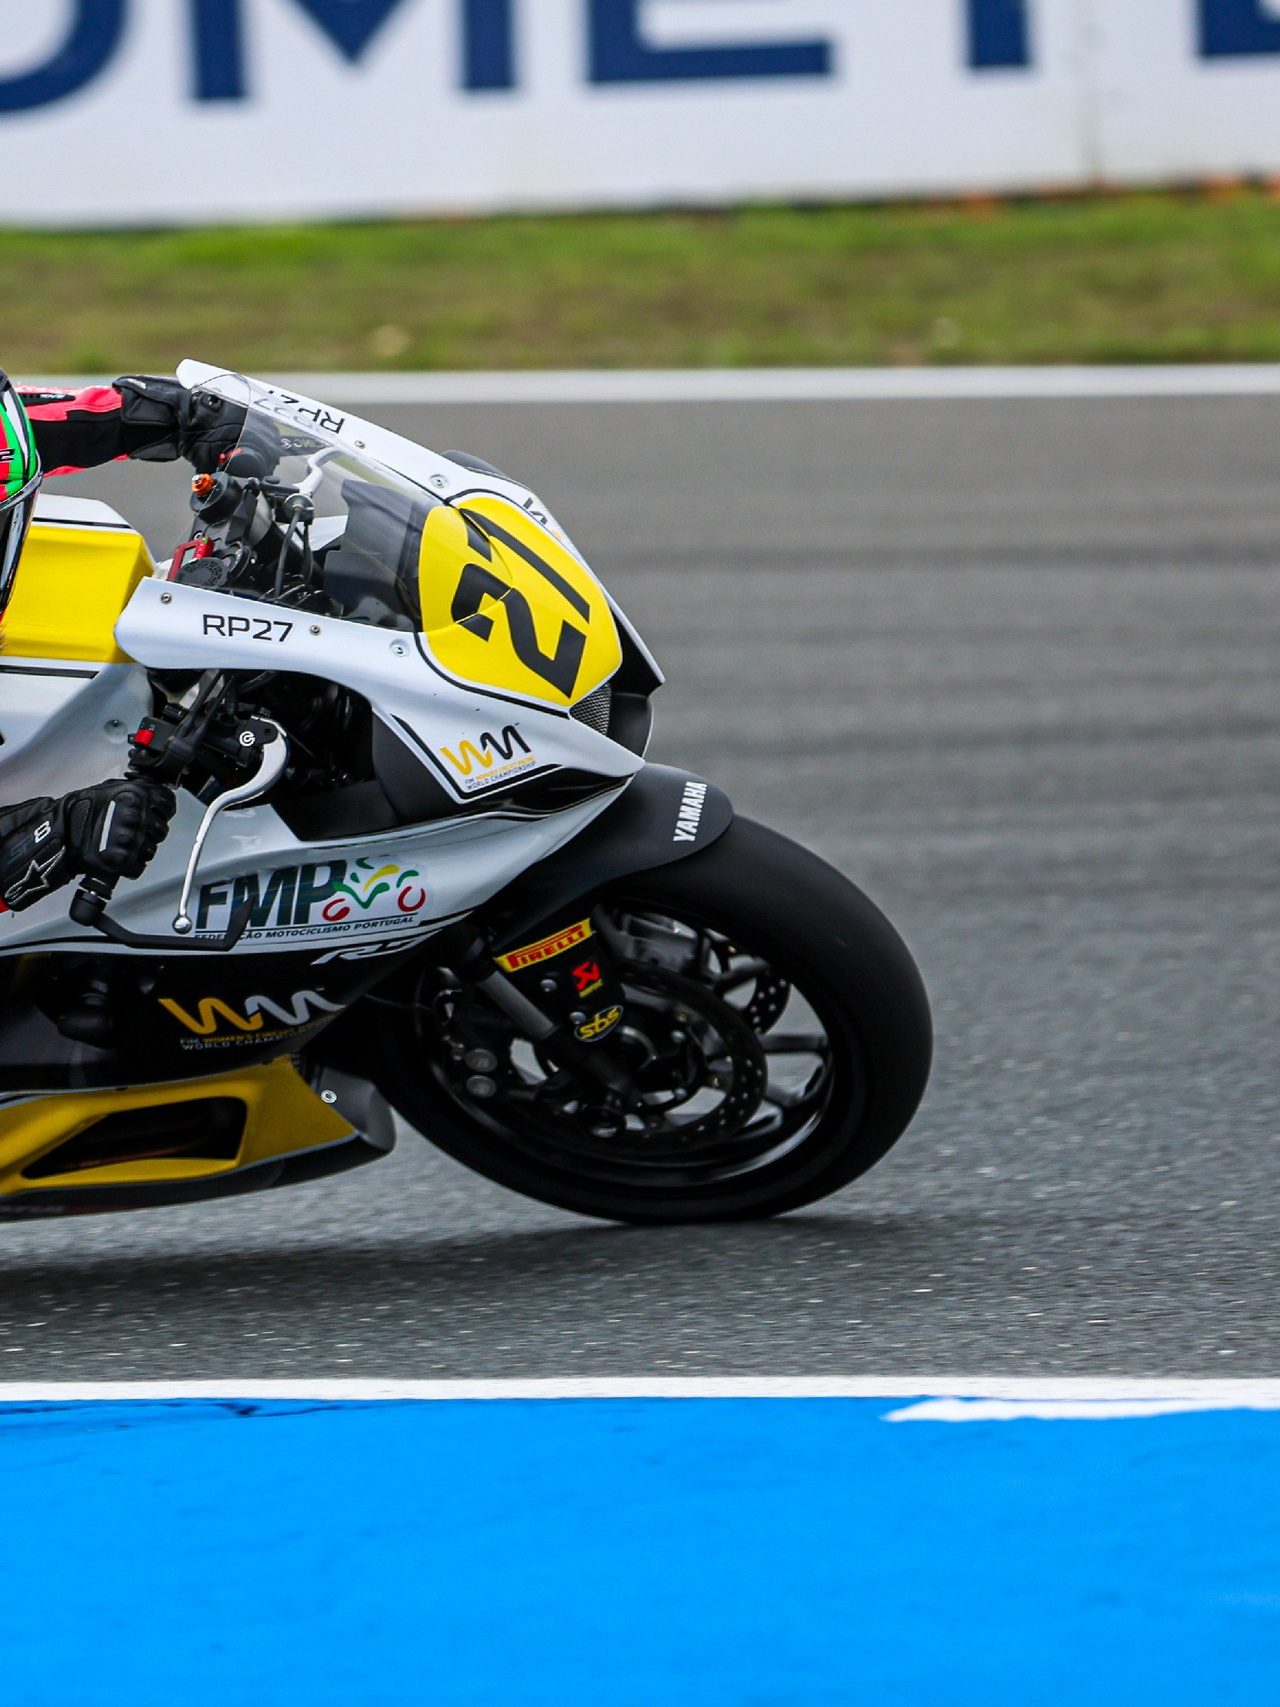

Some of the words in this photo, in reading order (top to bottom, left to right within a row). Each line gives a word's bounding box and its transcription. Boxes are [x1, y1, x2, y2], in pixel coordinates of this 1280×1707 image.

[451, 507, 591, 699] 27
[202, 613, 295, 644] RP27
[672, 780, 708, 842] YAMAHA
[195, 859, 350, 931] FMP
[265, 925, 351, 939] MOTOCICLISMO
[353, 916, 414, 930] PORTUGAL
[506, 924, 586, 969] PIRELLI
[182, 1039, 231, 1051] WORLD
